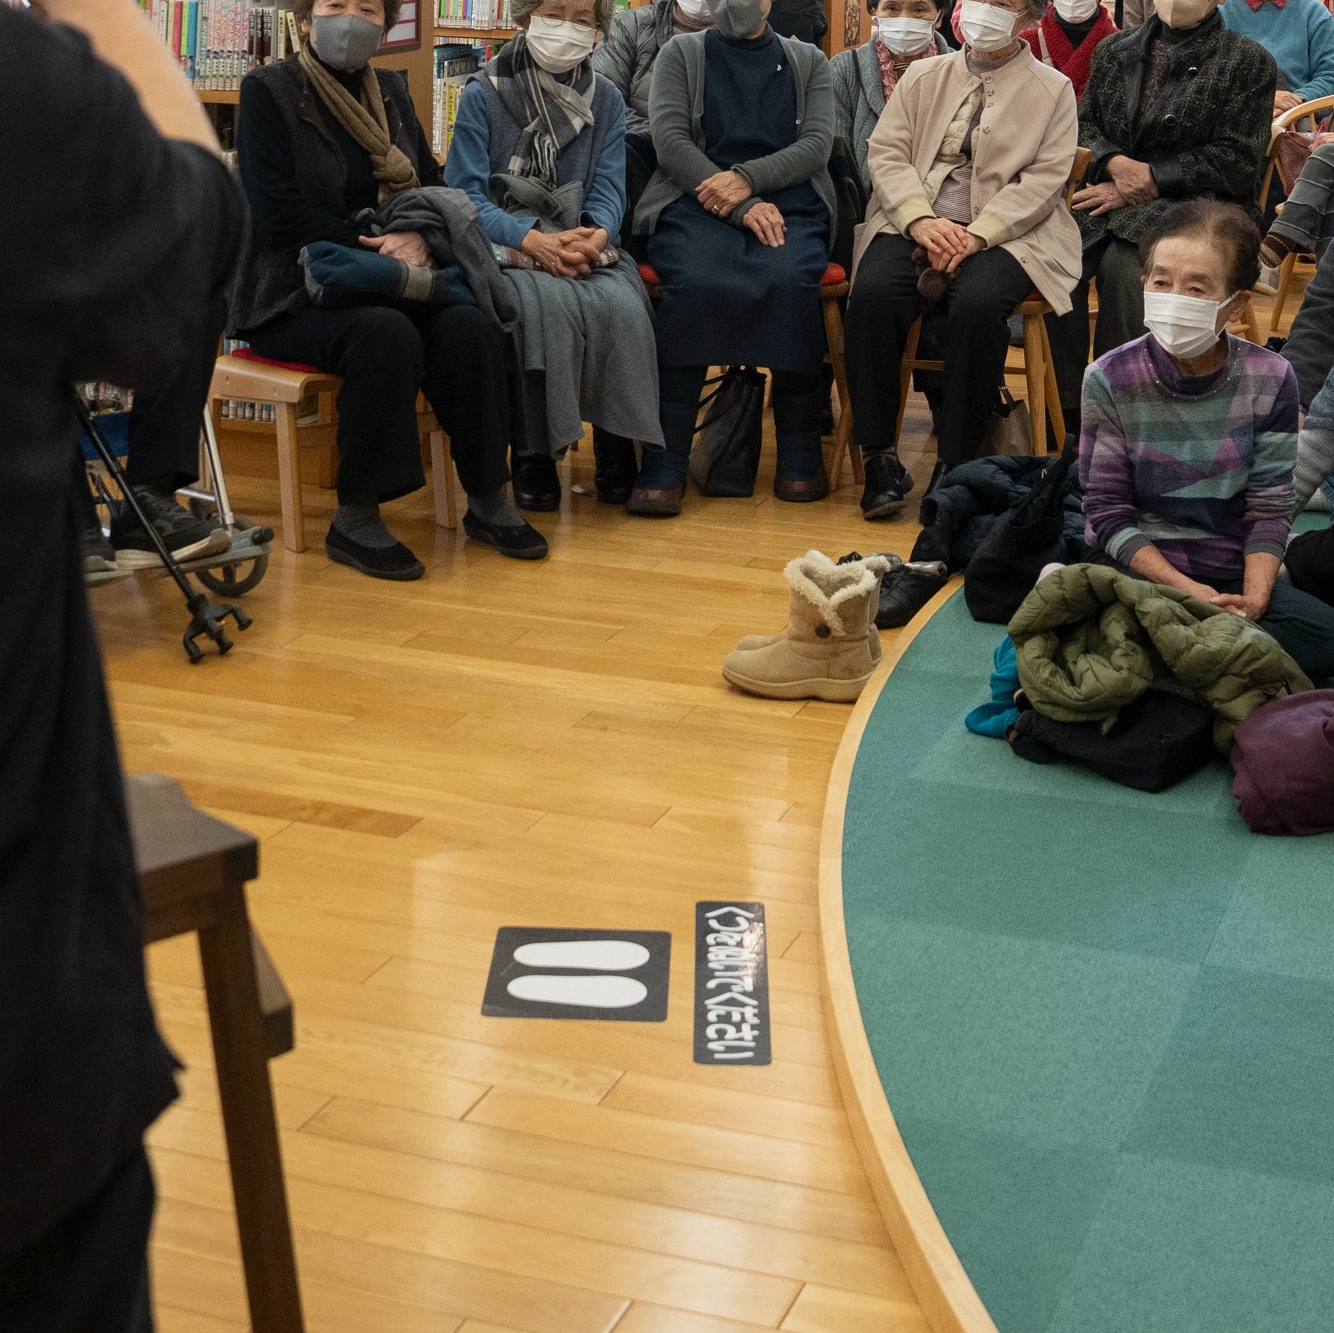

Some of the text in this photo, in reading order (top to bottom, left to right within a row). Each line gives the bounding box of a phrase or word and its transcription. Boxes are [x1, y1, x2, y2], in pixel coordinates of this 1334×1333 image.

[704, 905, 760, 1060] くつをぬいでください
